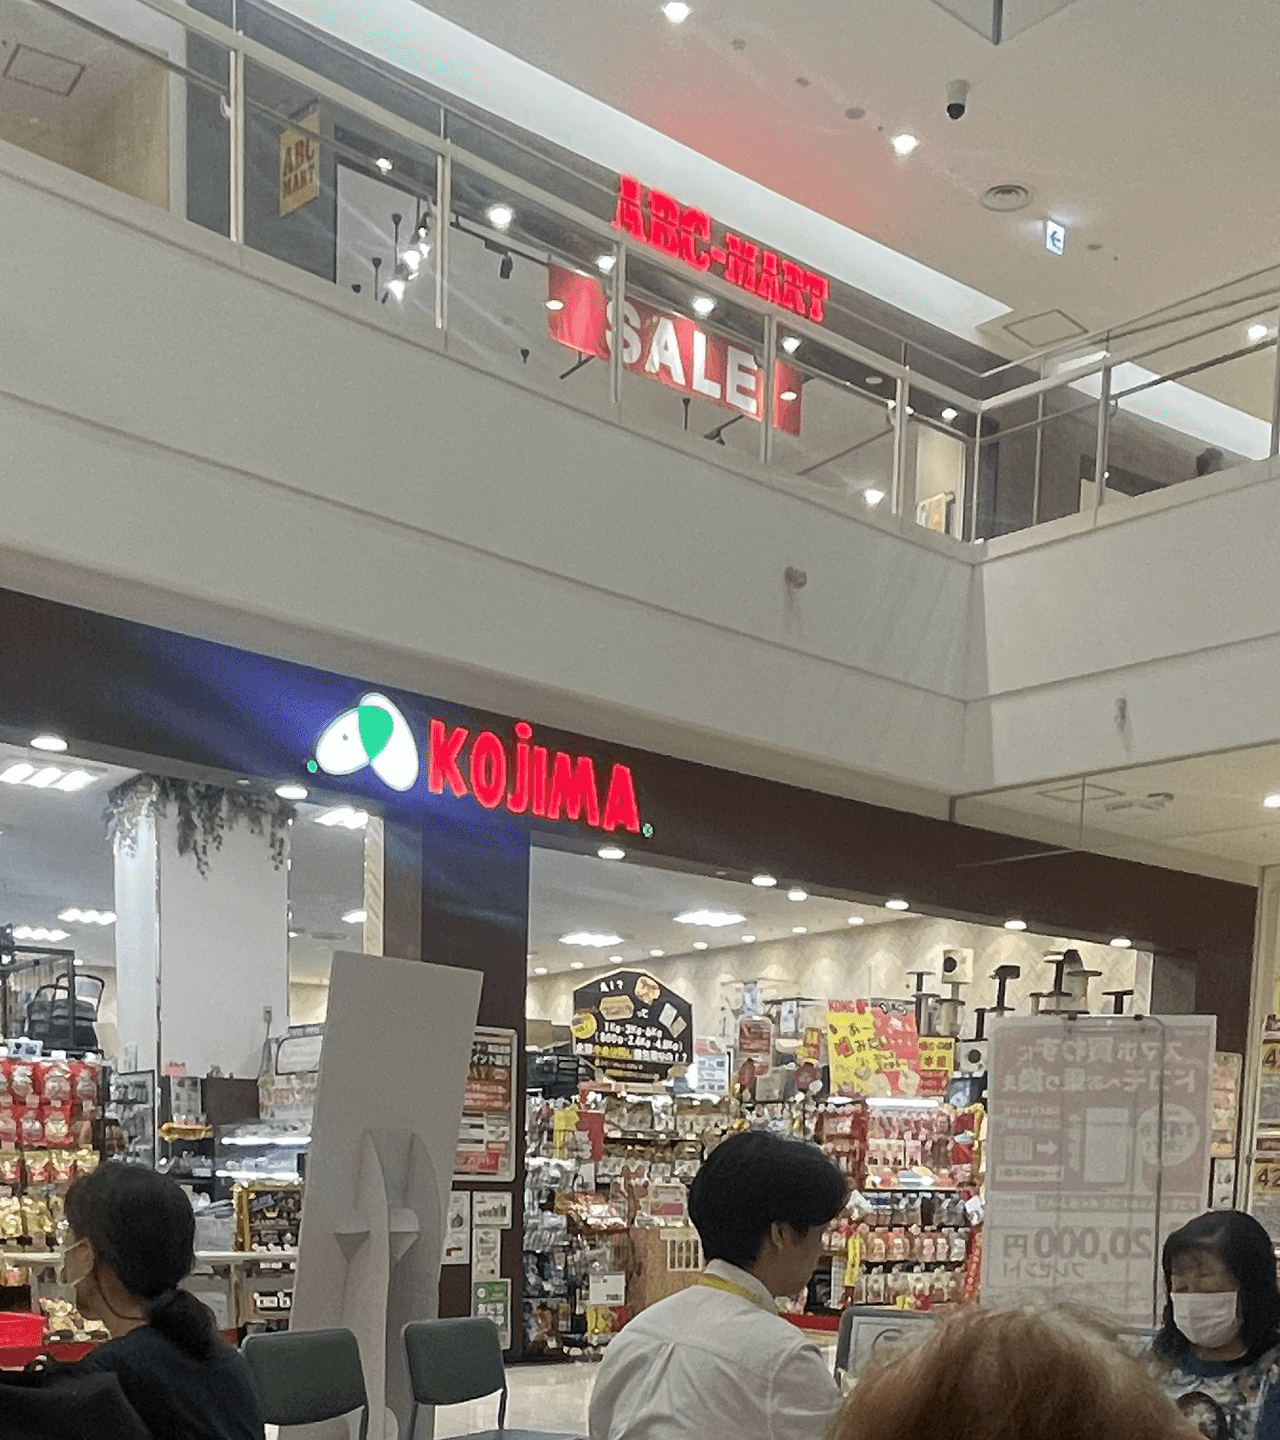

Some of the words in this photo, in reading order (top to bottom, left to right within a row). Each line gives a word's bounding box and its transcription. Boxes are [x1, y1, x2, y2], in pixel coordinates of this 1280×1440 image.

[283, 138, 315, 177] ABC
[283, 163, 315, 199] MART
[611, 173, 829, 324] ABC-MART
[606, 299, 757, 414] SALE
